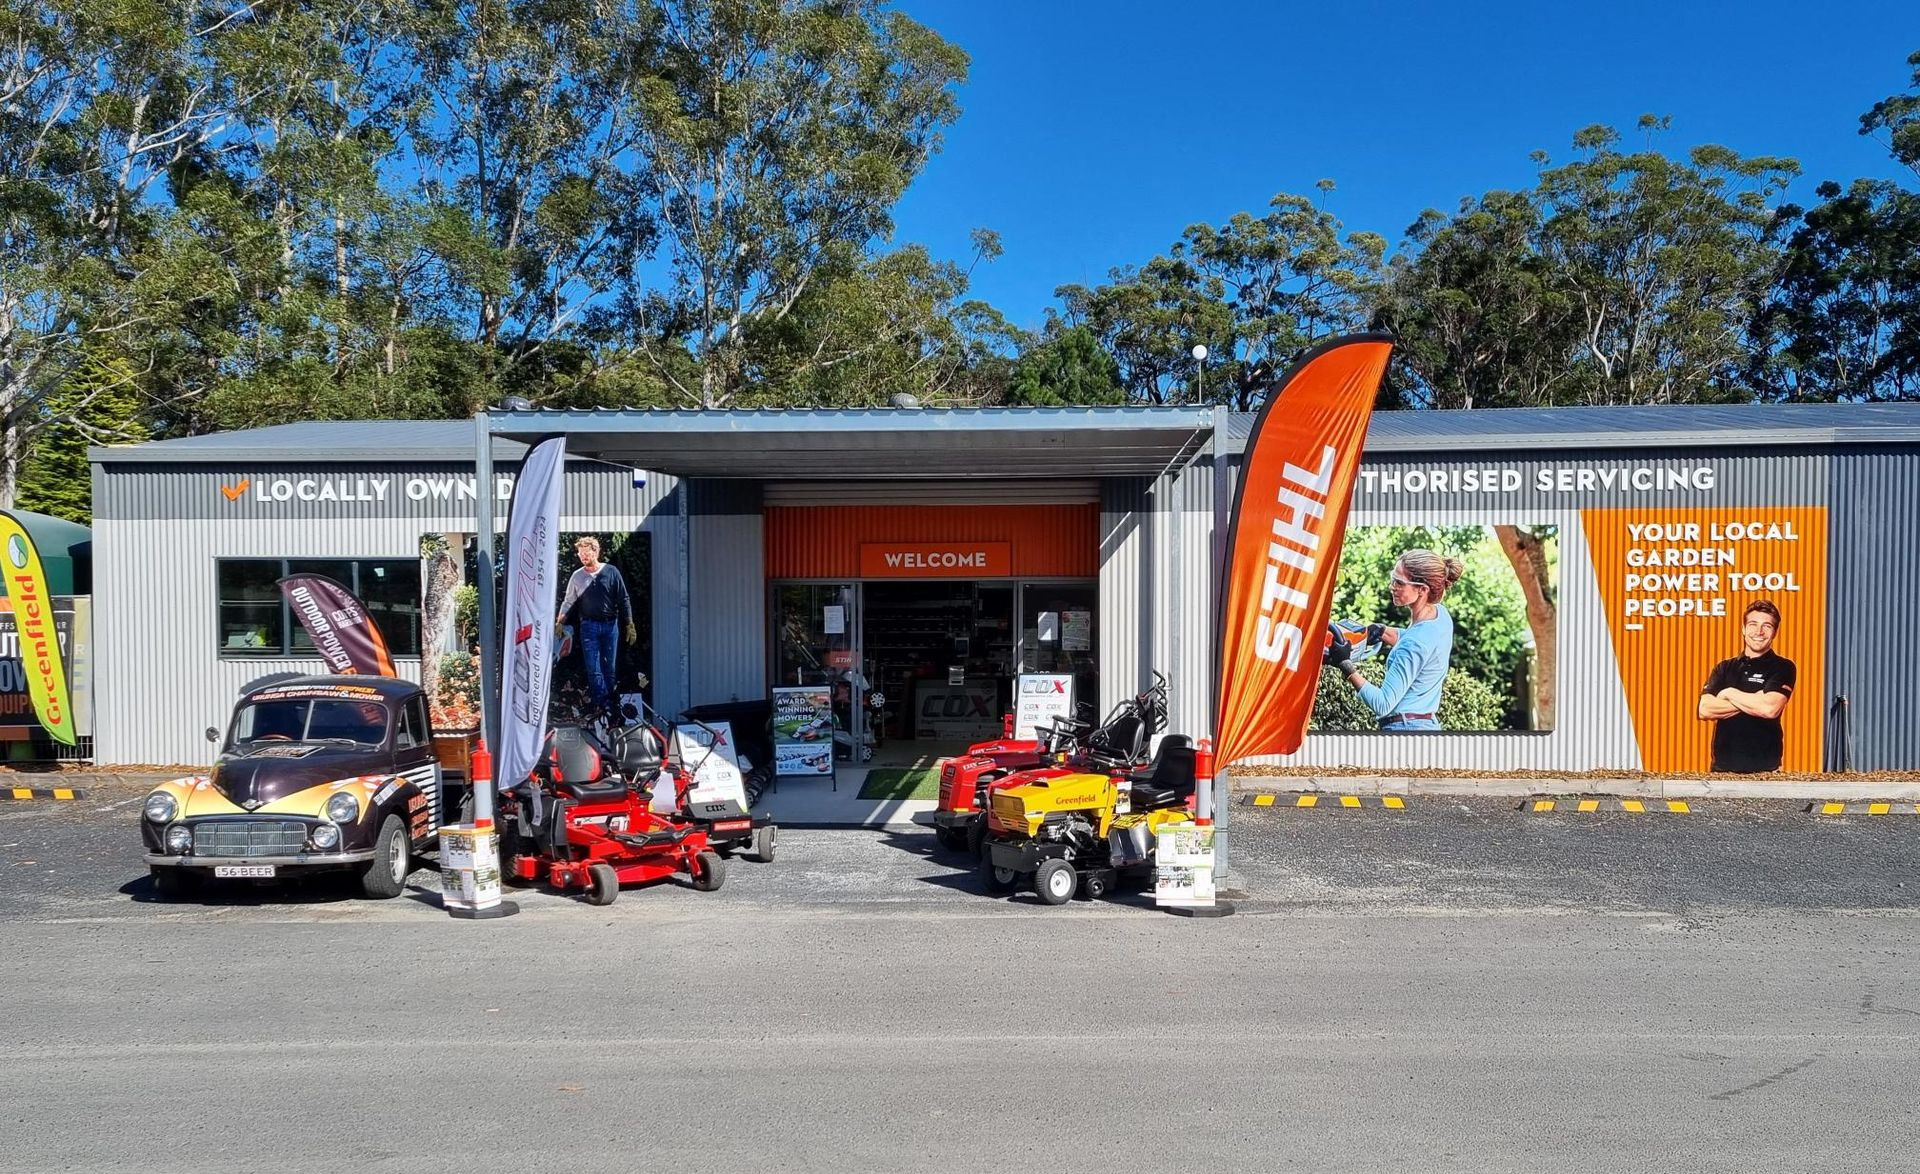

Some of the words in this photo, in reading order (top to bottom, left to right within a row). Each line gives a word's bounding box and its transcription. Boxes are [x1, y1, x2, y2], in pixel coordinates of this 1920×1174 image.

[1354, 470, 1522, 493] THORISED
[1536, 467, 1715, 491] SERVICING
[256, 480, 390, 501] LOCALLY
[406, 479, 514, 501] OWND
[1628, 523, 1700, 541] YOUR
[1711, 522, 1798, 541] LOCAL
[885, 552, 986, 568] WELCOME
[1255, 444, 1336, 672] STIHL
[1626, 548, 1735, 567] GARDEN
[1625, 574, 1719, 592] POWER
[1728, 573, 1800, 591] TOOL
[1625, 599, 1726, 617] PEOPLE
[0, 622, 15, 630] FFS
[291, 587, 330, 634] OUTDOOR
[320, 630, 352, 670] POWER
[15, 575, 62, 725] Greenfield
[533, 646, 541, 664] for
[1023, 679, 1068, 694] COX
[531, 666, 541, 728] Engineered
[705, 804, 726, 812] COX
[1056, 794, 1096, 805] Greenfield
